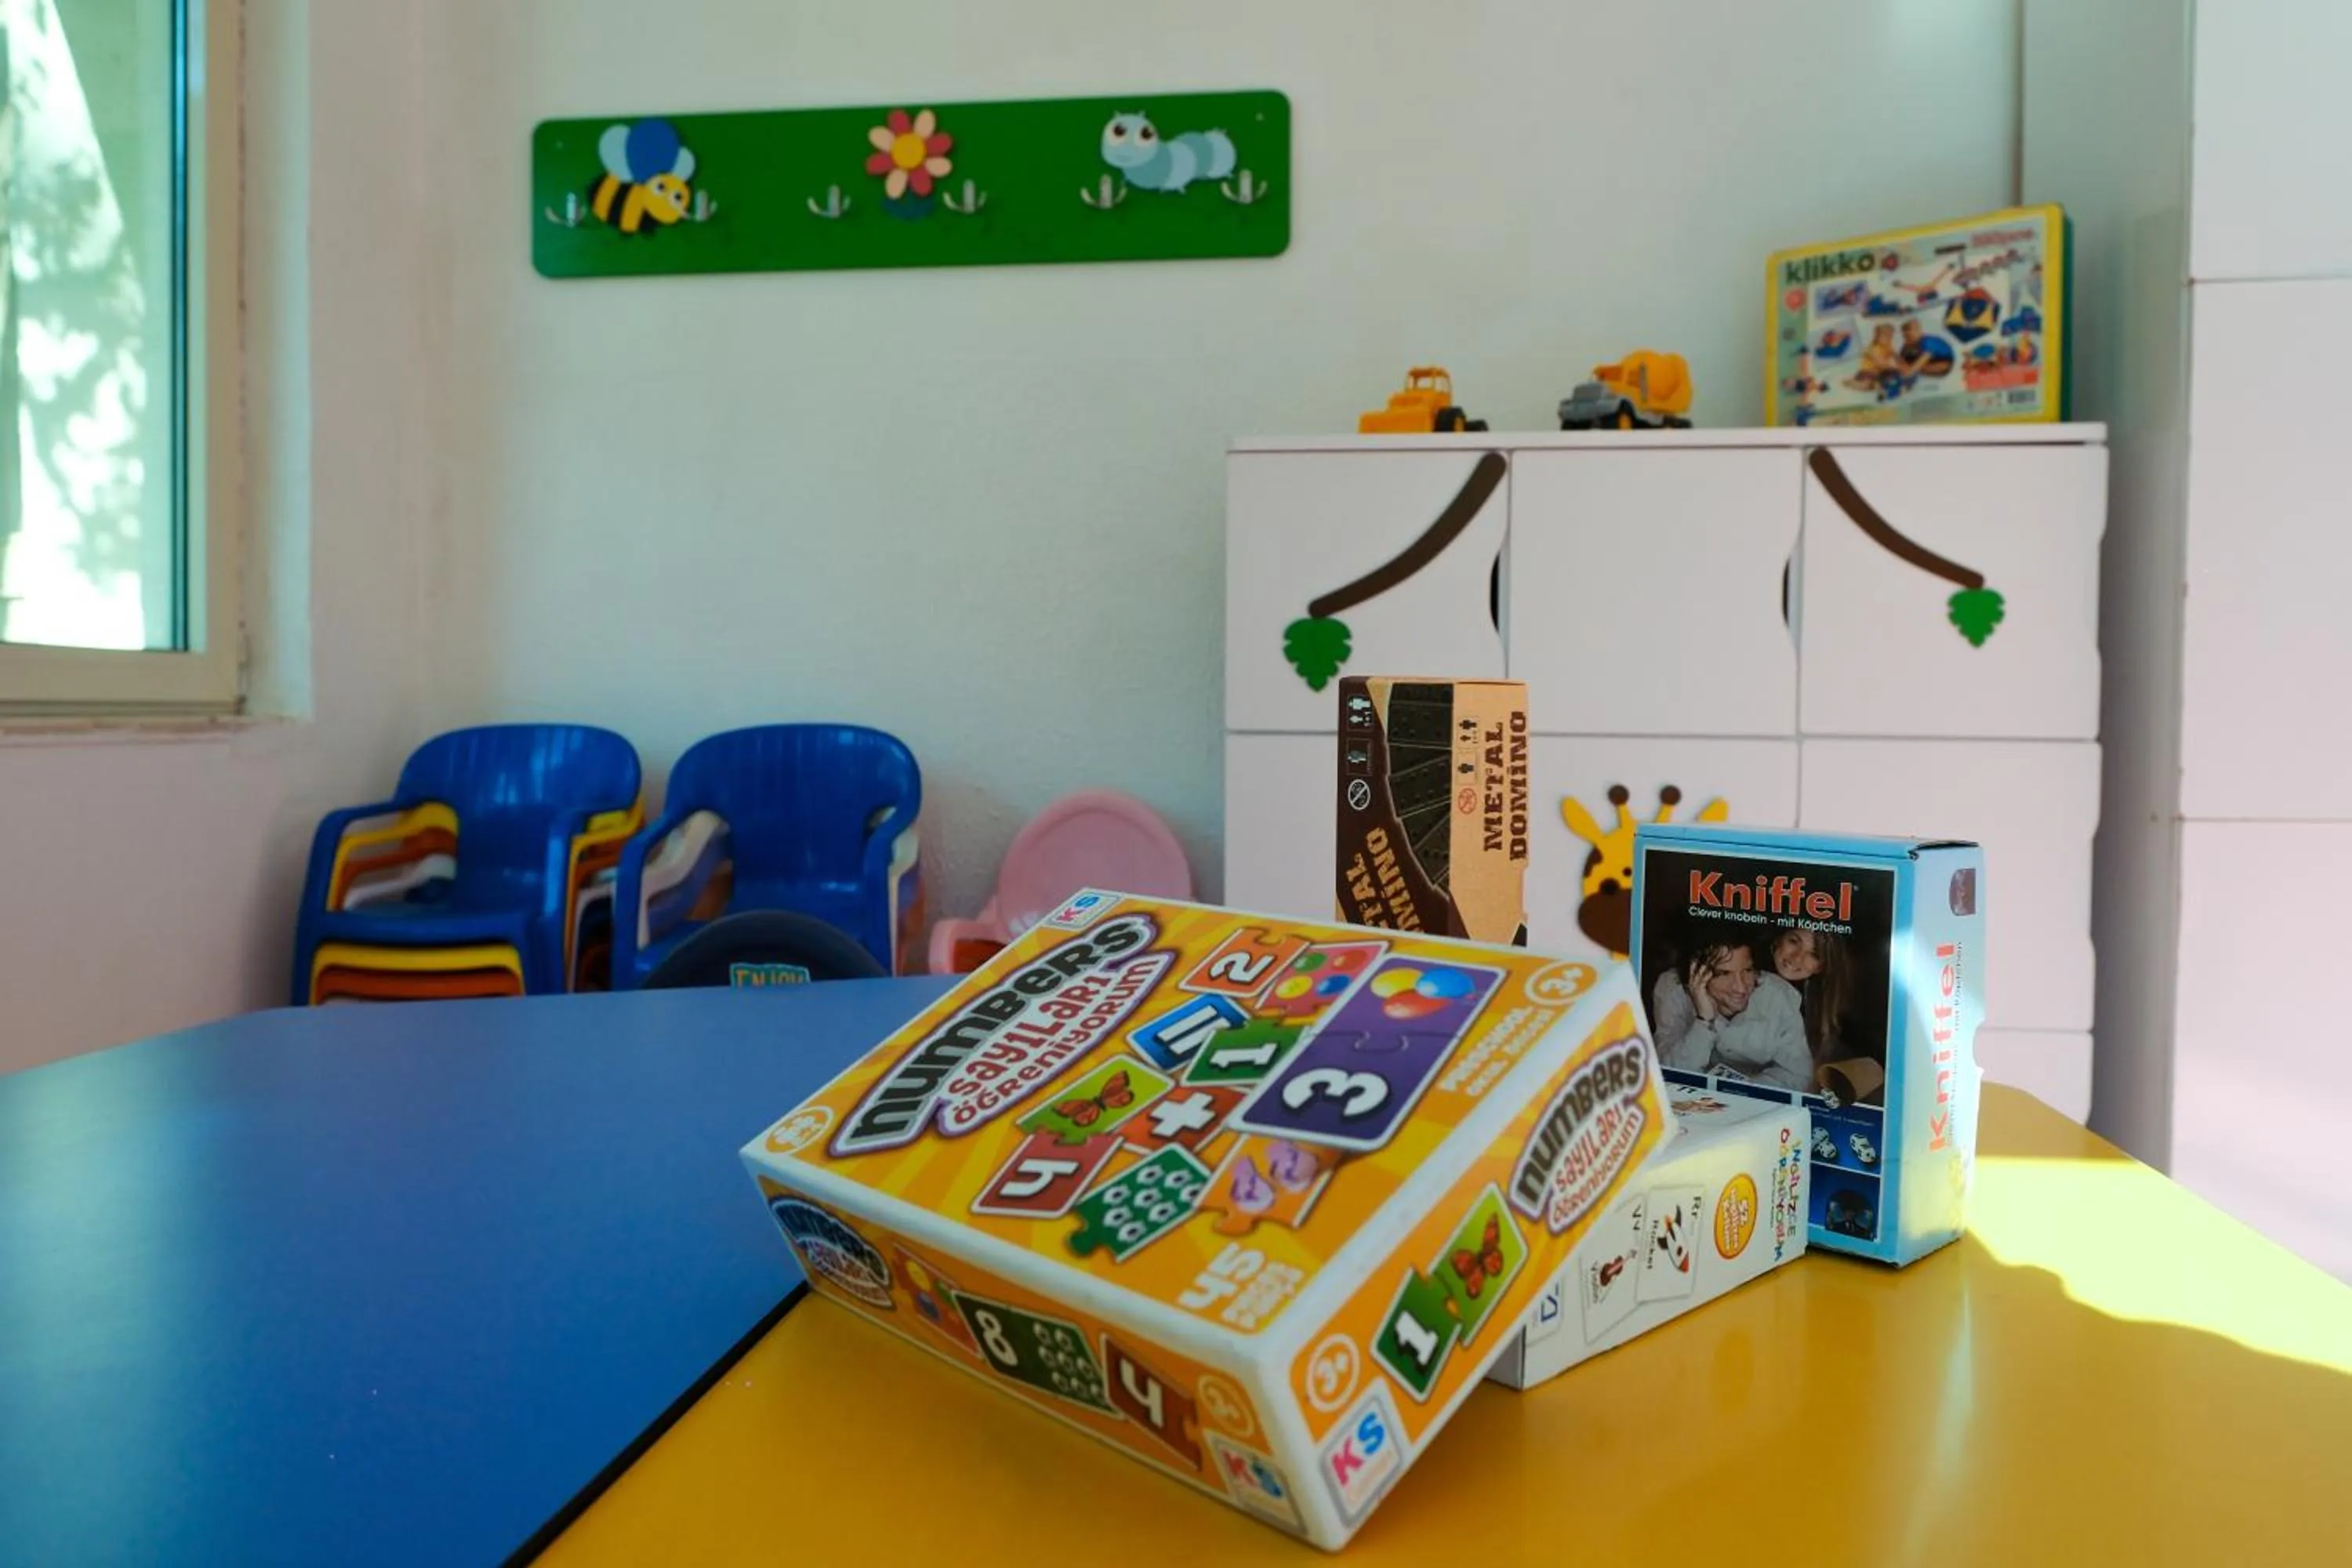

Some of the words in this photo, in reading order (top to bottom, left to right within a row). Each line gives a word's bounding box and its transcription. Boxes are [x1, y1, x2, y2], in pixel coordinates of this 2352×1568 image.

[1483, 722, 1504, 852] METAL
[1055, 895, 1101, 923] KS
[1688, 906, 1722, 920] Clever
[1777, 916, 1795, 928] mit
[1690, 869, 1853, 921] Kniffel
[1210, 953, 1275, 982] 2
[1210, 1043, 1278, 1069] 1
[1929, 944, 1955, 1152] Kniffel
[1283, 1069, 1390, 1116] 3
[999, 1156, 1080, 1198] 4
[1178, 1242, 1266, 1309] 45
[975, 1308, 1019, 1367] 8
[1392, 1310, 1439, 1366] 1
[1120, 1357, 1165, 1428] 4
[1221, 1451, 1283, 1498] KS
[1330, 1411, 1385, 1487] KS
